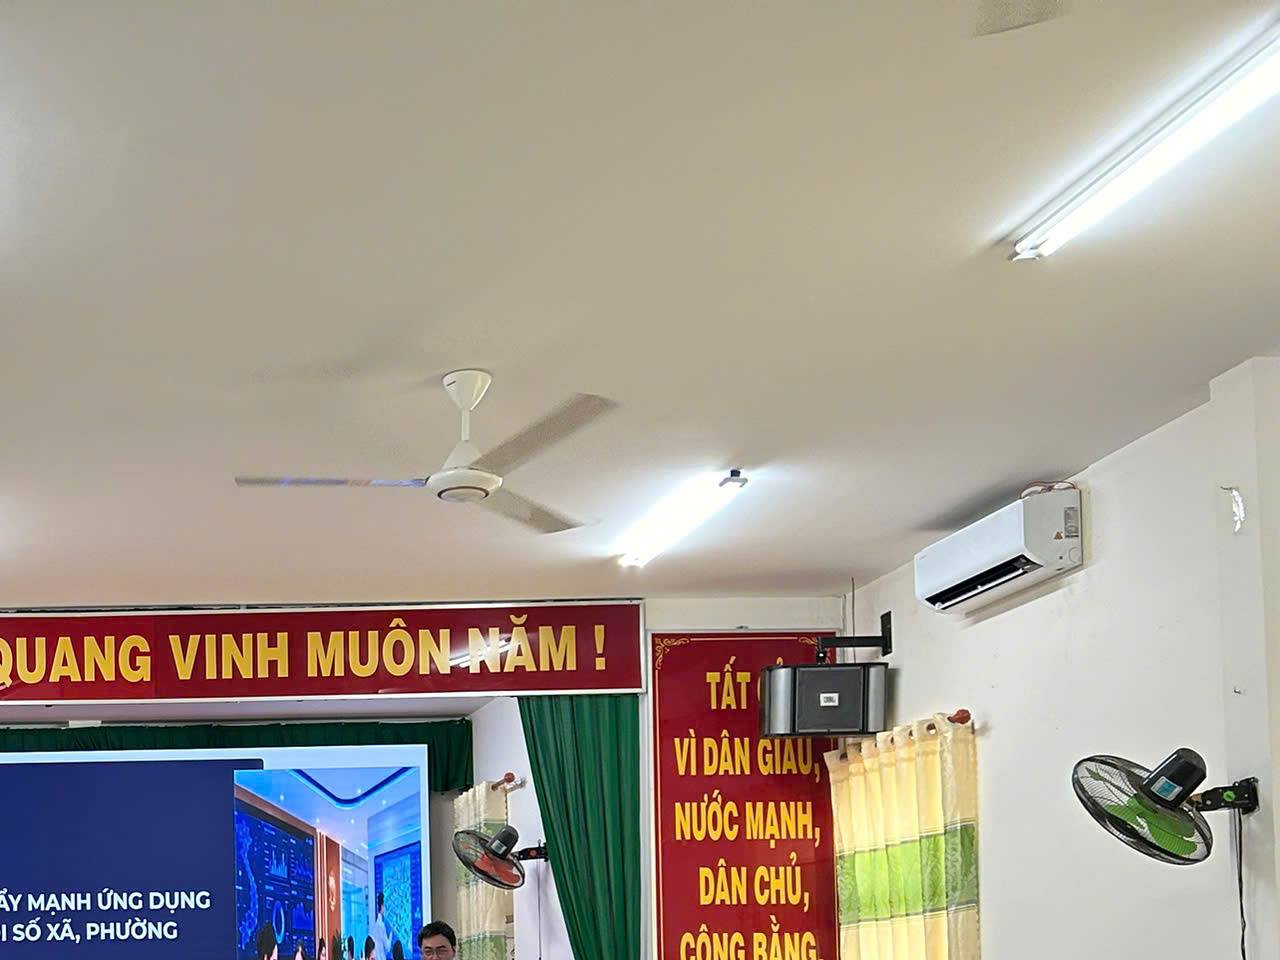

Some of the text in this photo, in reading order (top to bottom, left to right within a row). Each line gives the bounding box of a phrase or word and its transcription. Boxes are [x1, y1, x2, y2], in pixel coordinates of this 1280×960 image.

[169, 632, 288, 679] VINH
[308, 617, 451, 678] MUÔN
[467, 614, 577, 674] NĂM
[595, 625, 605, 670] !
[707, 656, 750, 709] TẤT
[674, 729, 696, 775] VÌ
[704, 730, 750, 775] DÂN
[675, 790, 820, 848] NƯỚC MẠNH,
[28, 892, 91, 916] MẠNH
[98, 888, 142, 910] ỨNG
[150, 891, 210, 913] DỤNG
[699, 852, 809, 912] DÂN CHỦ,
[13, 917, 41, 941] SỐ
[47, 919, 80, 943] XÃ,
[87, 918, 177, 939] PHƯỜNG
